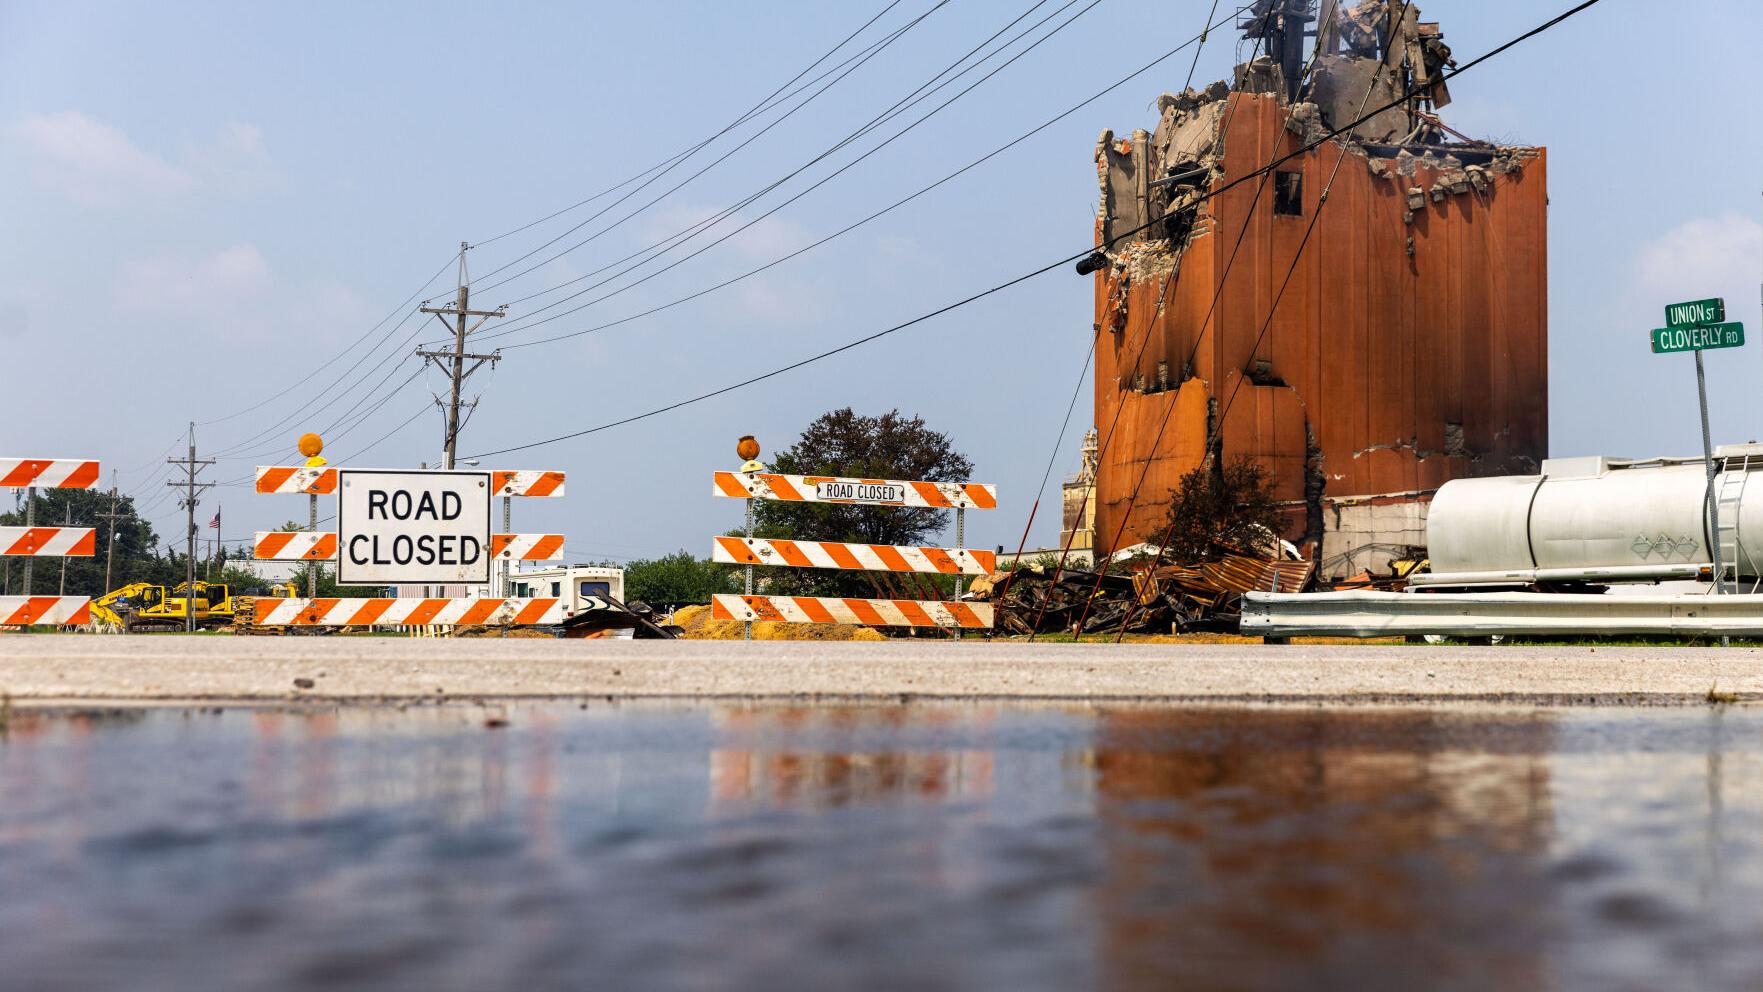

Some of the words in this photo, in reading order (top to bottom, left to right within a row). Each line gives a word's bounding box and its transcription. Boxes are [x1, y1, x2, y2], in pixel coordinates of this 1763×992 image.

[1670, 304, 1705, 325] UNION
[1706, 307, 1715, 321] ST
[1660, 327, 1723, 350] CLOVERLY
[1726, 331, 1738, 344] RD
[826, 483, 853, 498] ROAD
[858, 485, 895, 500] CLOSED
[369, 489, 462, 521] ROAD
[349, 534, 480, 566] CLOSED
